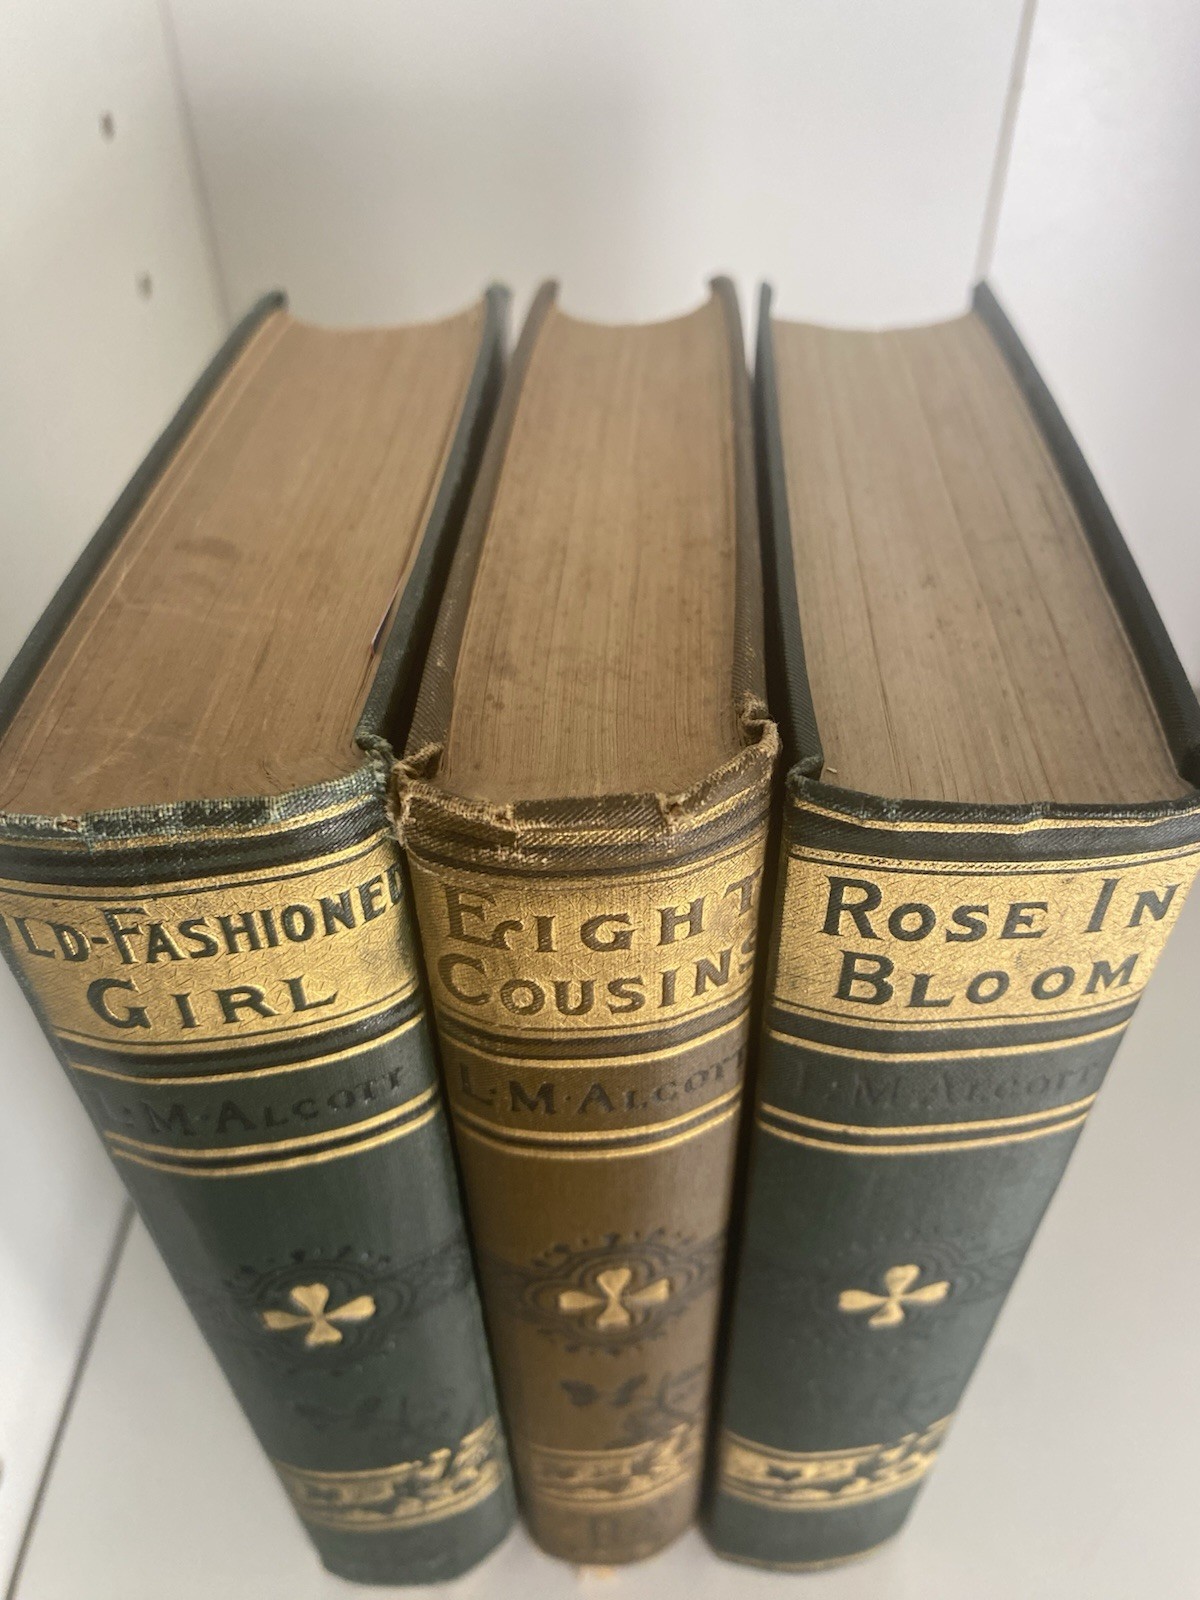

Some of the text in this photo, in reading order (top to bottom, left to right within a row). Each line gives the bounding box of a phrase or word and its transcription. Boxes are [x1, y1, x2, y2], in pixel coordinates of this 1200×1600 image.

[3, 863, 403, 964] LD-FASHIONED
[445, 867, 764, 953] EIGHT
[819, 874, 1181, 943] ROSE IN
[86, 975, 339, 1030] GIRL
[832, 949, 1139, 1008] BLOOM
